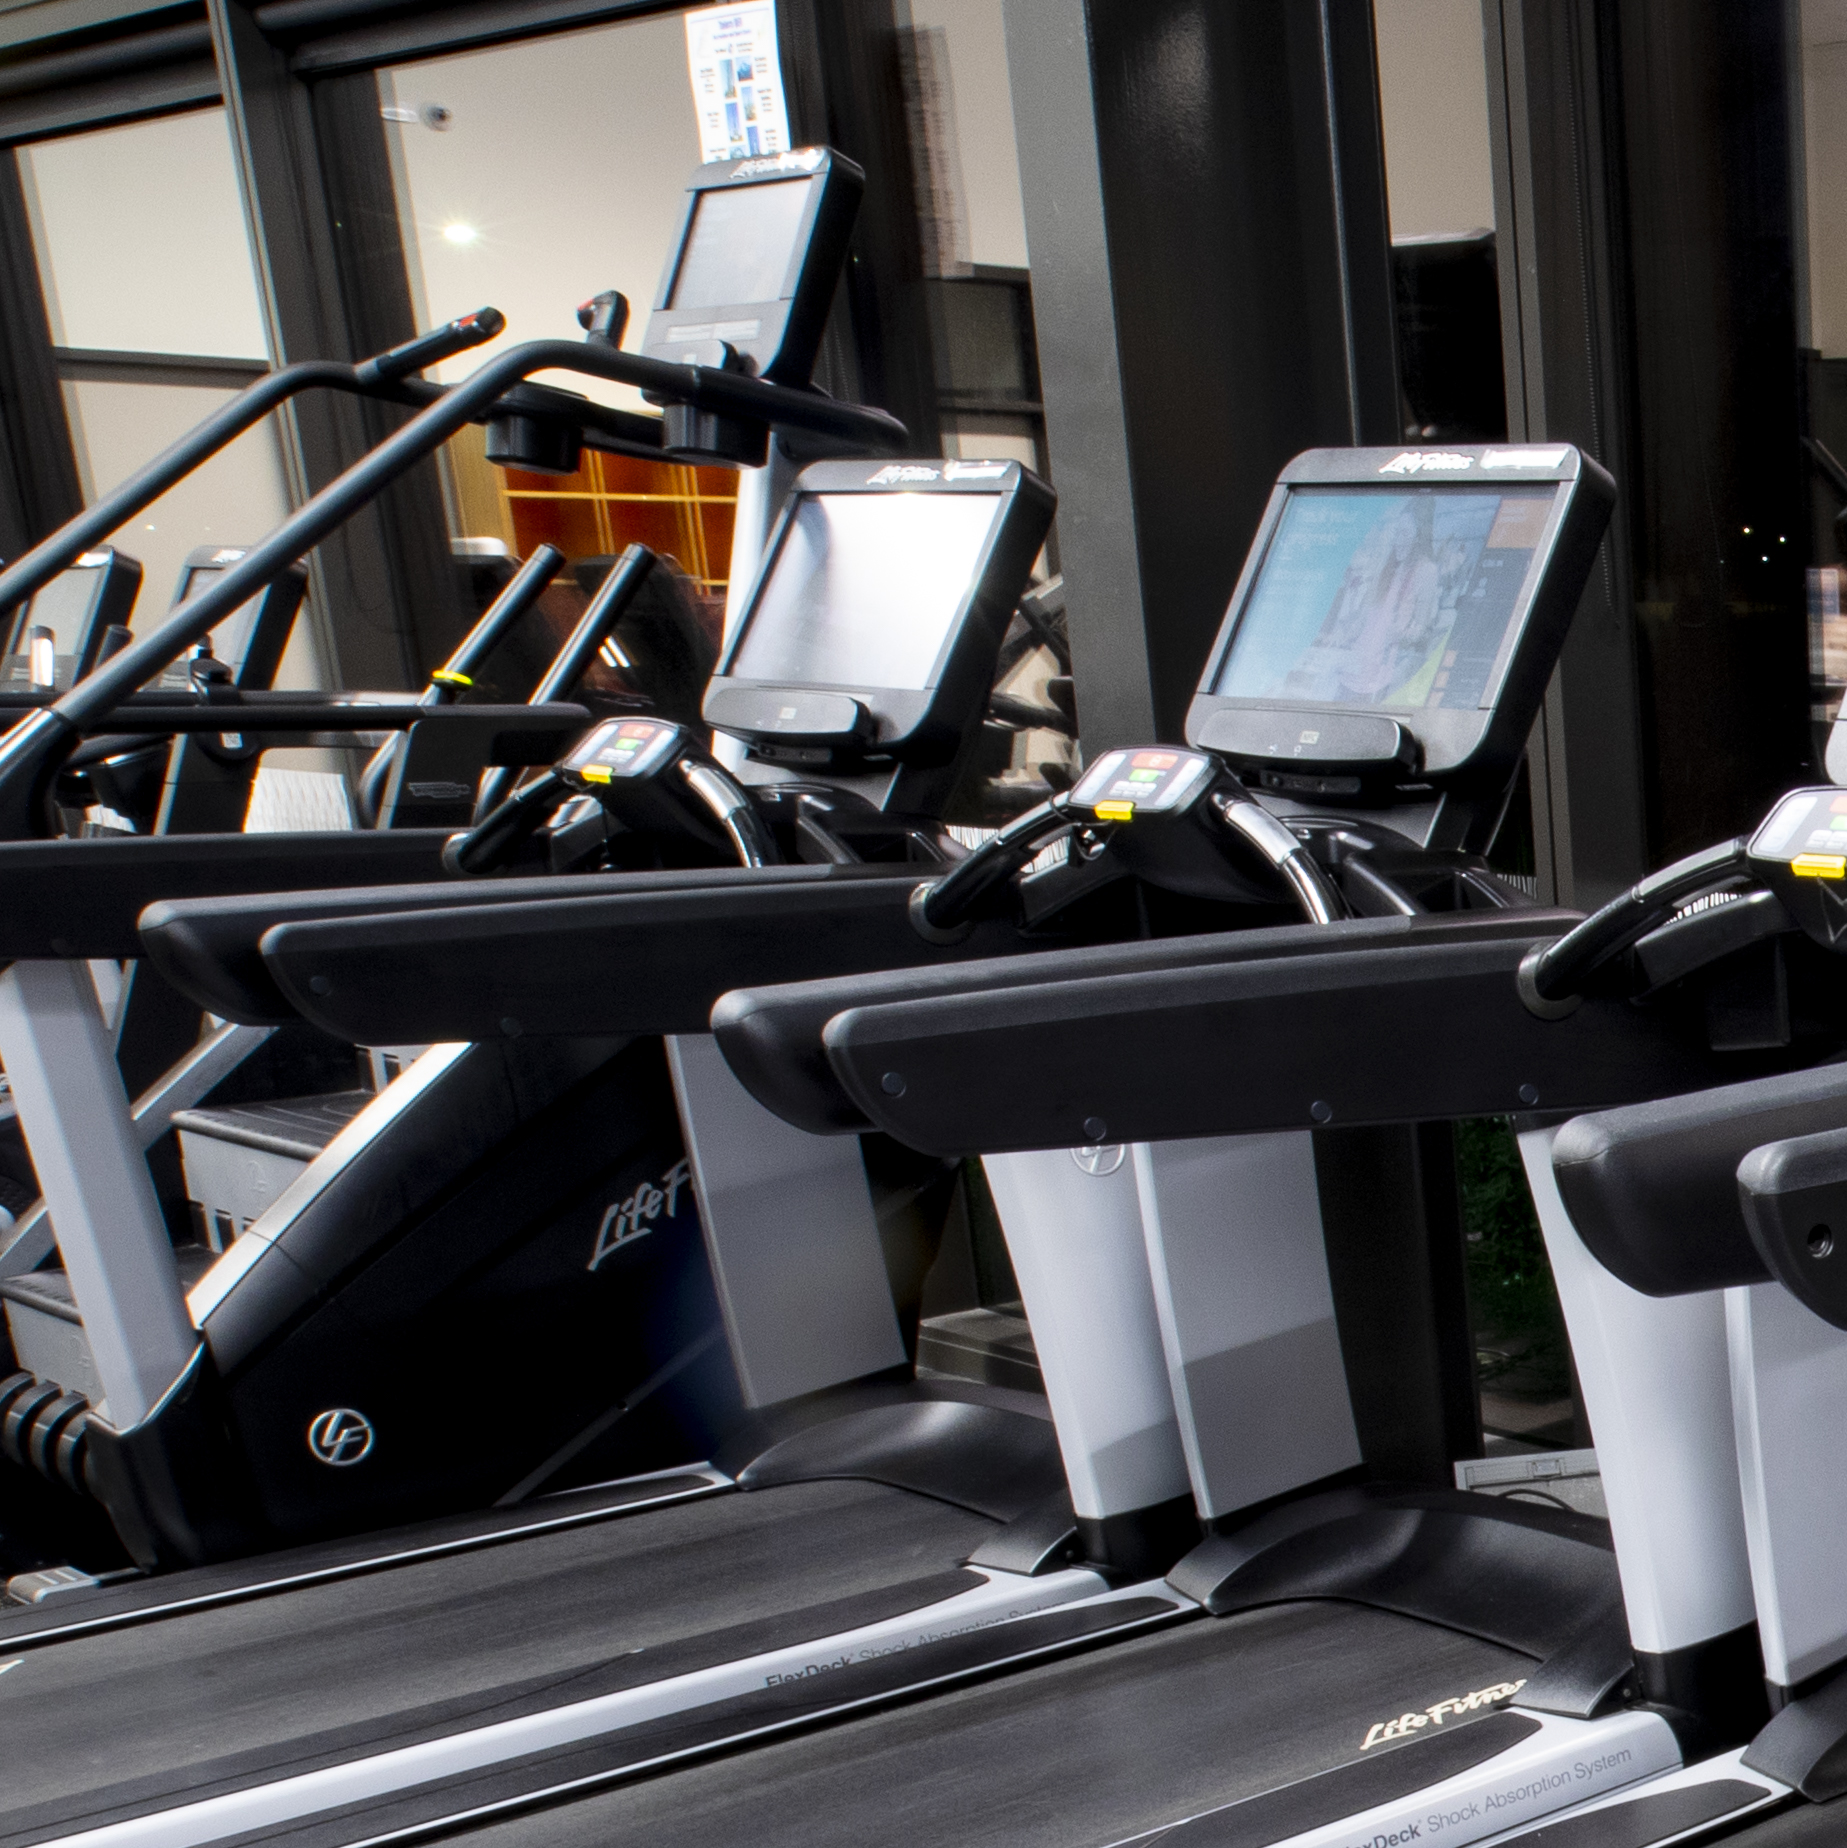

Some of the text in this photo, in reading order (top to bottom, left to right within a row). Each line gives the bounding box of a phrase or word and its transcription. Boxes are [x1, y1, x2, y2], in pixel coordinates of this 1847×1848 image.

[586, 1182, 664, 1271] Life
[1359, 1712, 1429, 1751] Life
[1426, 1803, 1481, 1833] Shock
[1484, 1769, 1573, 1812] Absorption
[1574, 1748, 1632, 1784] System
